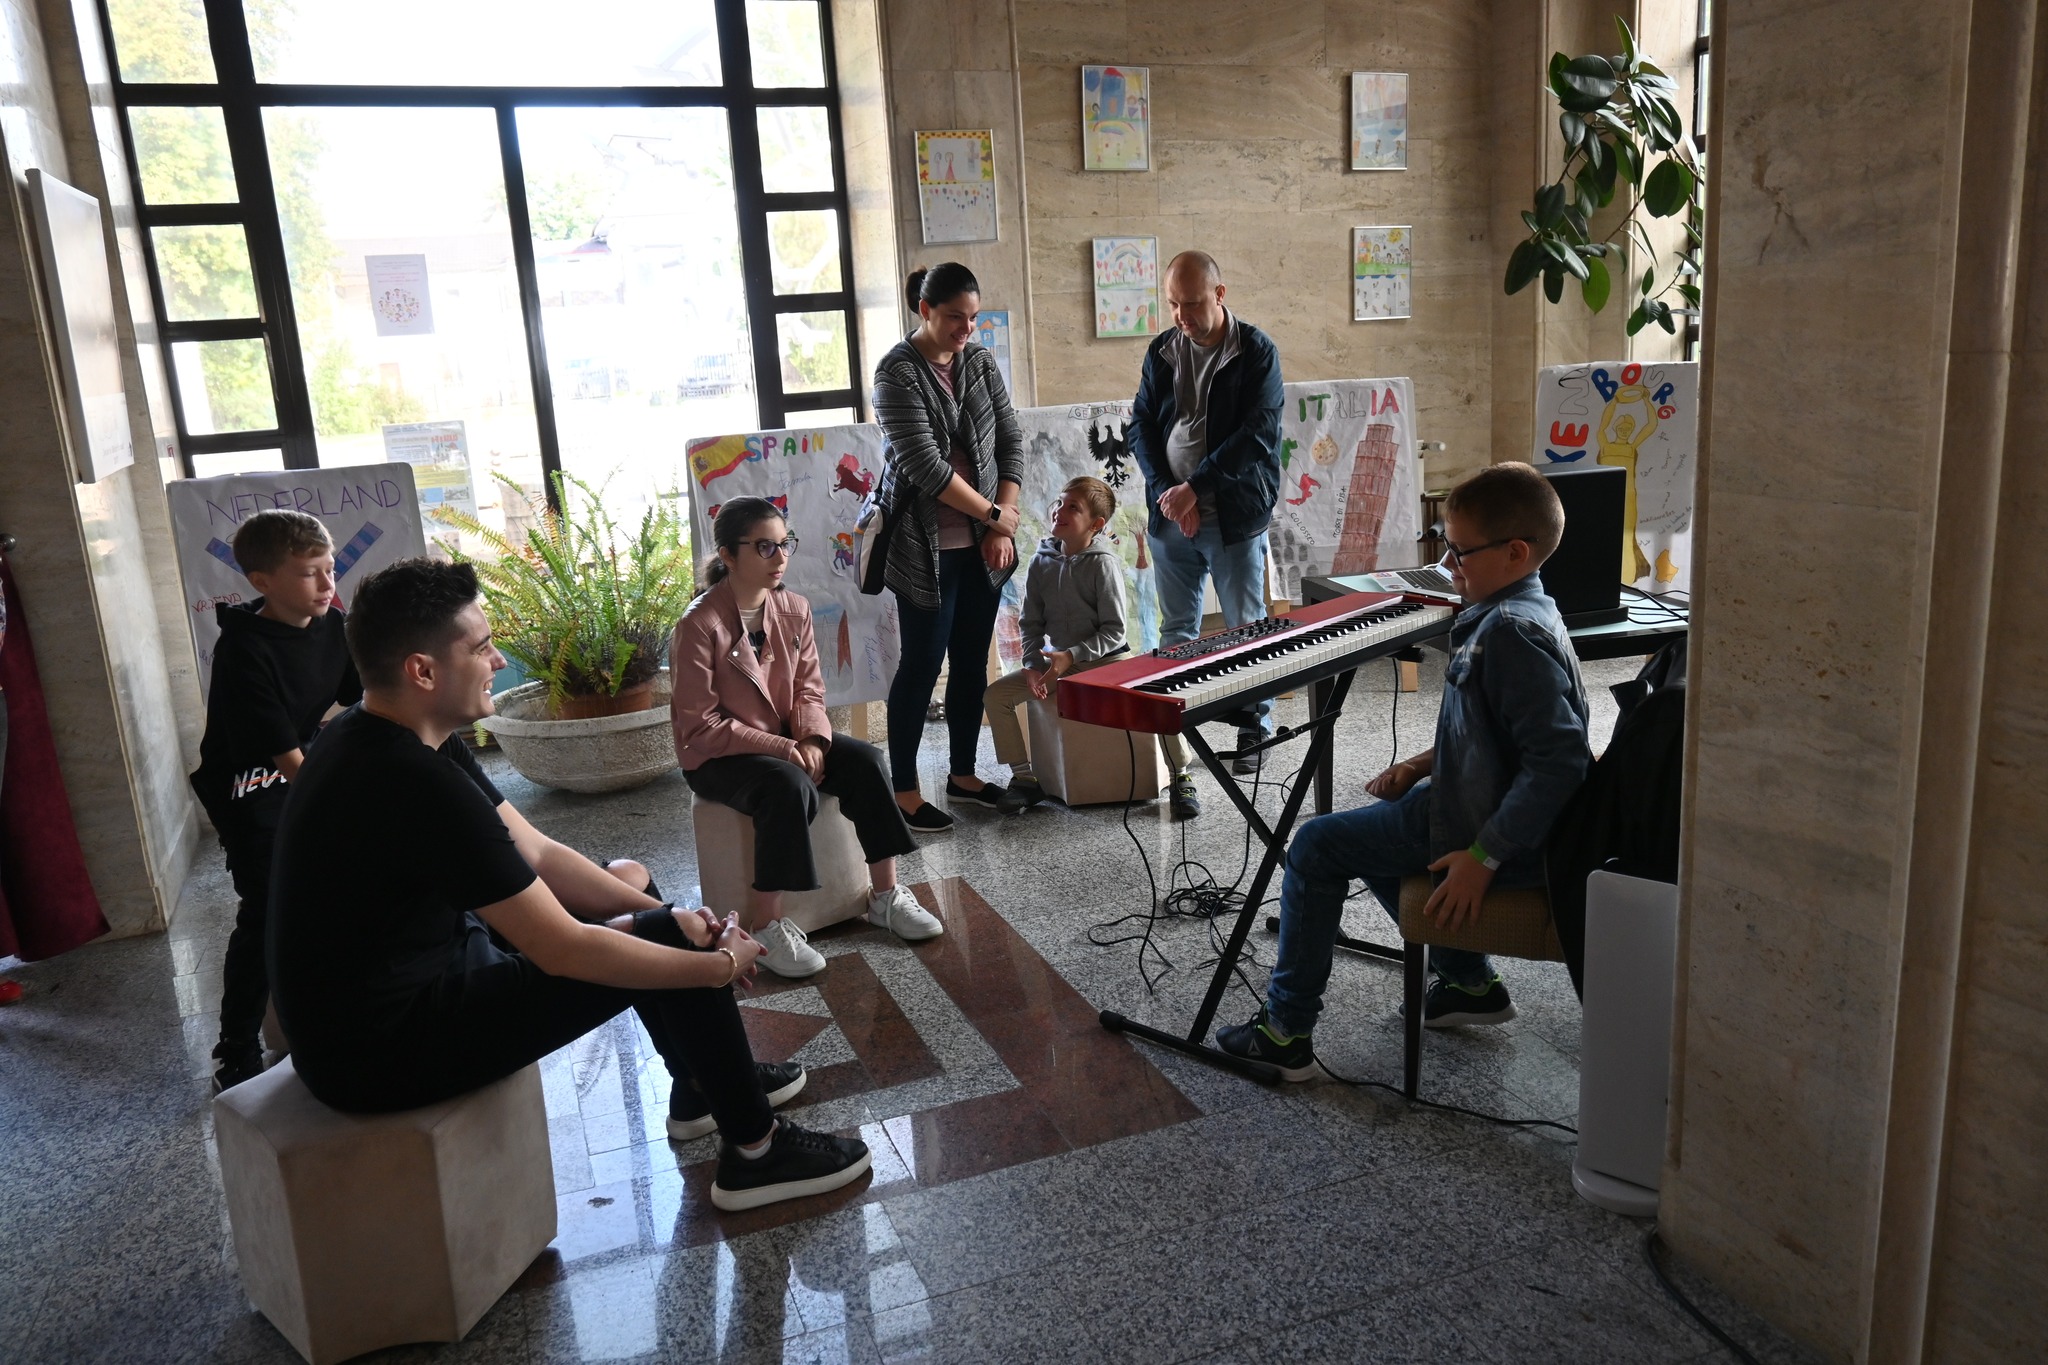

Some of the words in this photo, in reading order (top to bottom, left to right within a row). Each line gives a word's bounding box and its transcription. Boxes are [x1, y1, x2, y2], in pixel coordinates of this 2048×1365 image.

[1298, 387, 1400, 423] ITALIA
[206, 480, 401, 526] NEDERLAND
[1290, 512, 1315, 545] COLOSSEO
